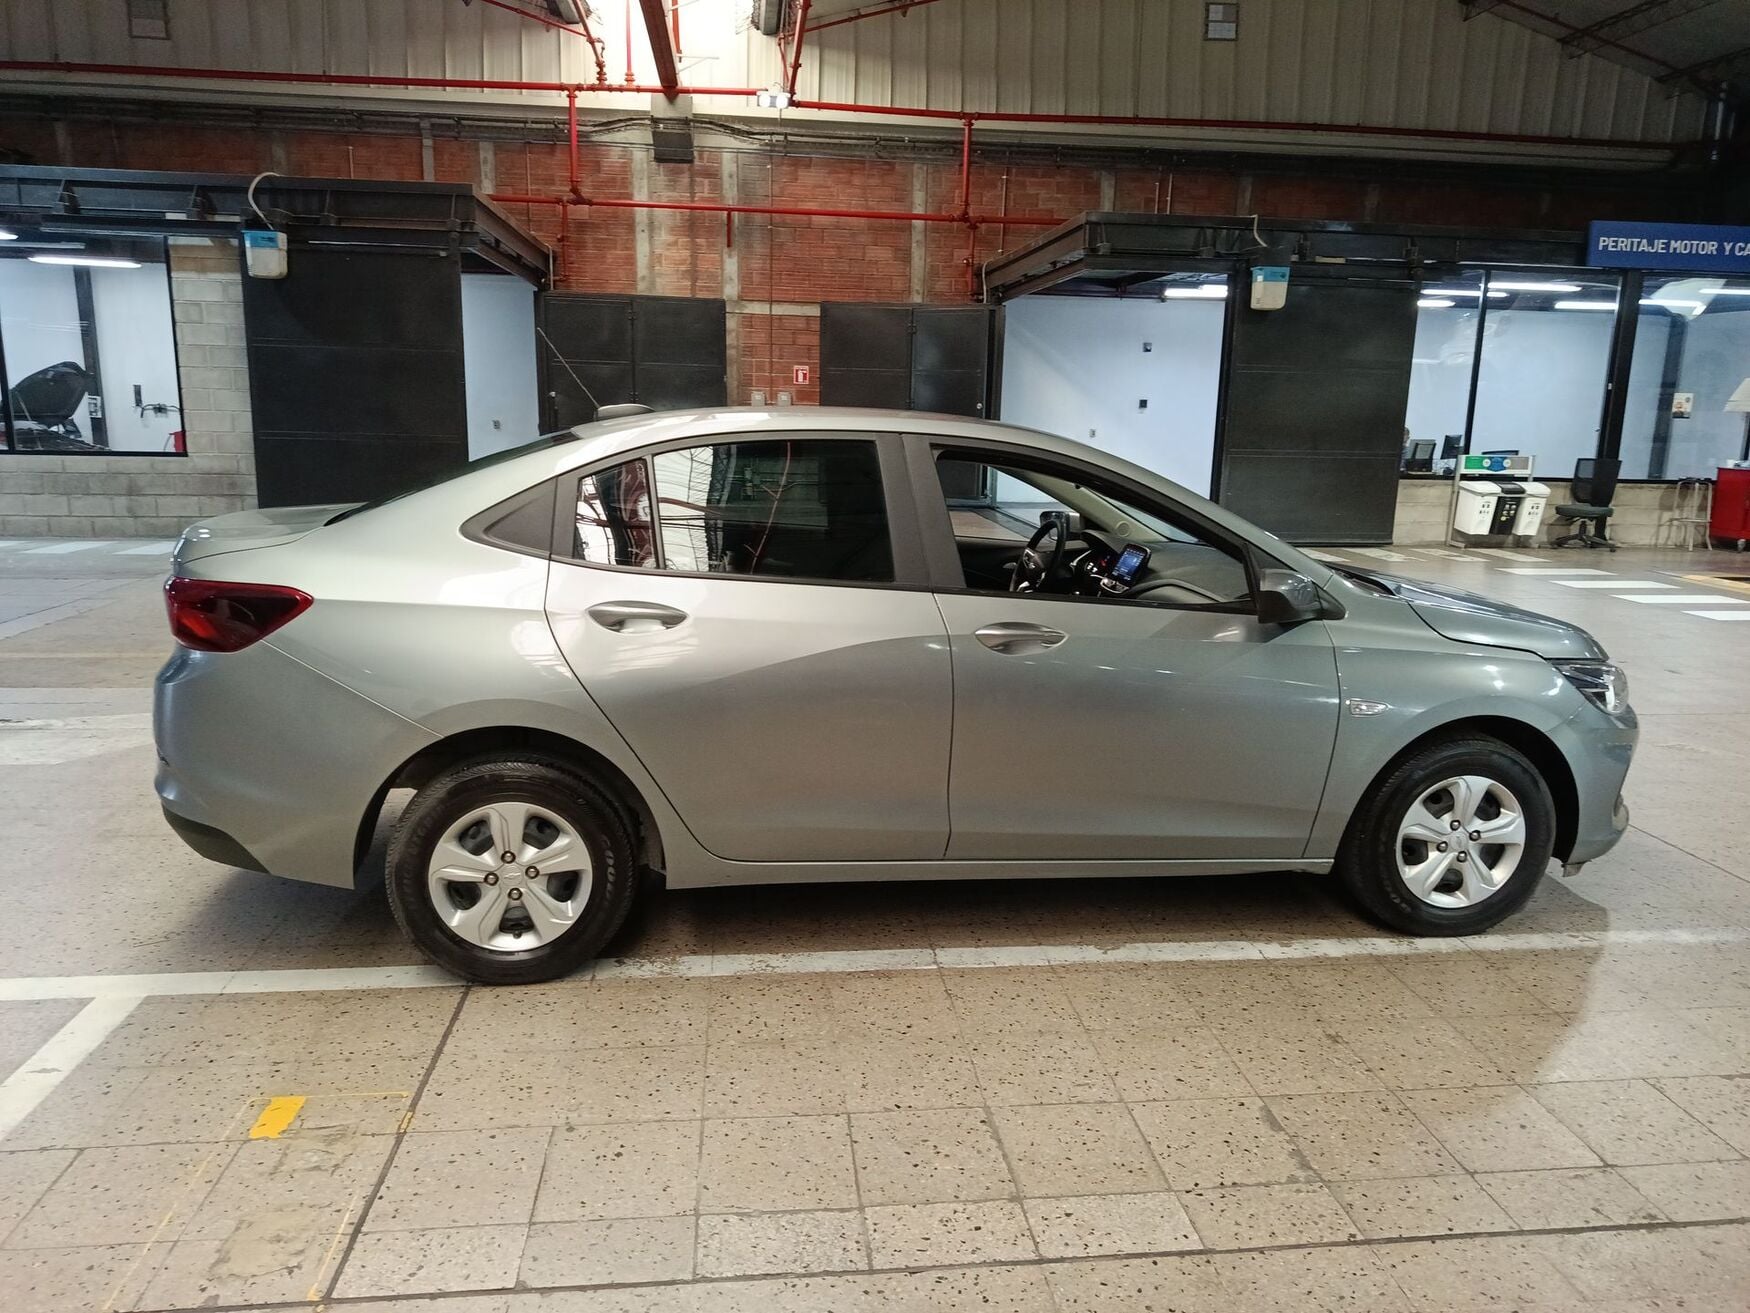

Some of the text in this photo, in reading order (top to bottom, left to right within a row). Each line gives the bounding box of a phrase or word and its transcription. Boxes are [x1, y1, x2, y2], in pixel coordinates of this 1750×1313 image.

[1598, 237, 1667, 253] PERITAJE
[1669, 240, 1718, 254] MOTOR
[1723, 242, 1734, 255] Y
